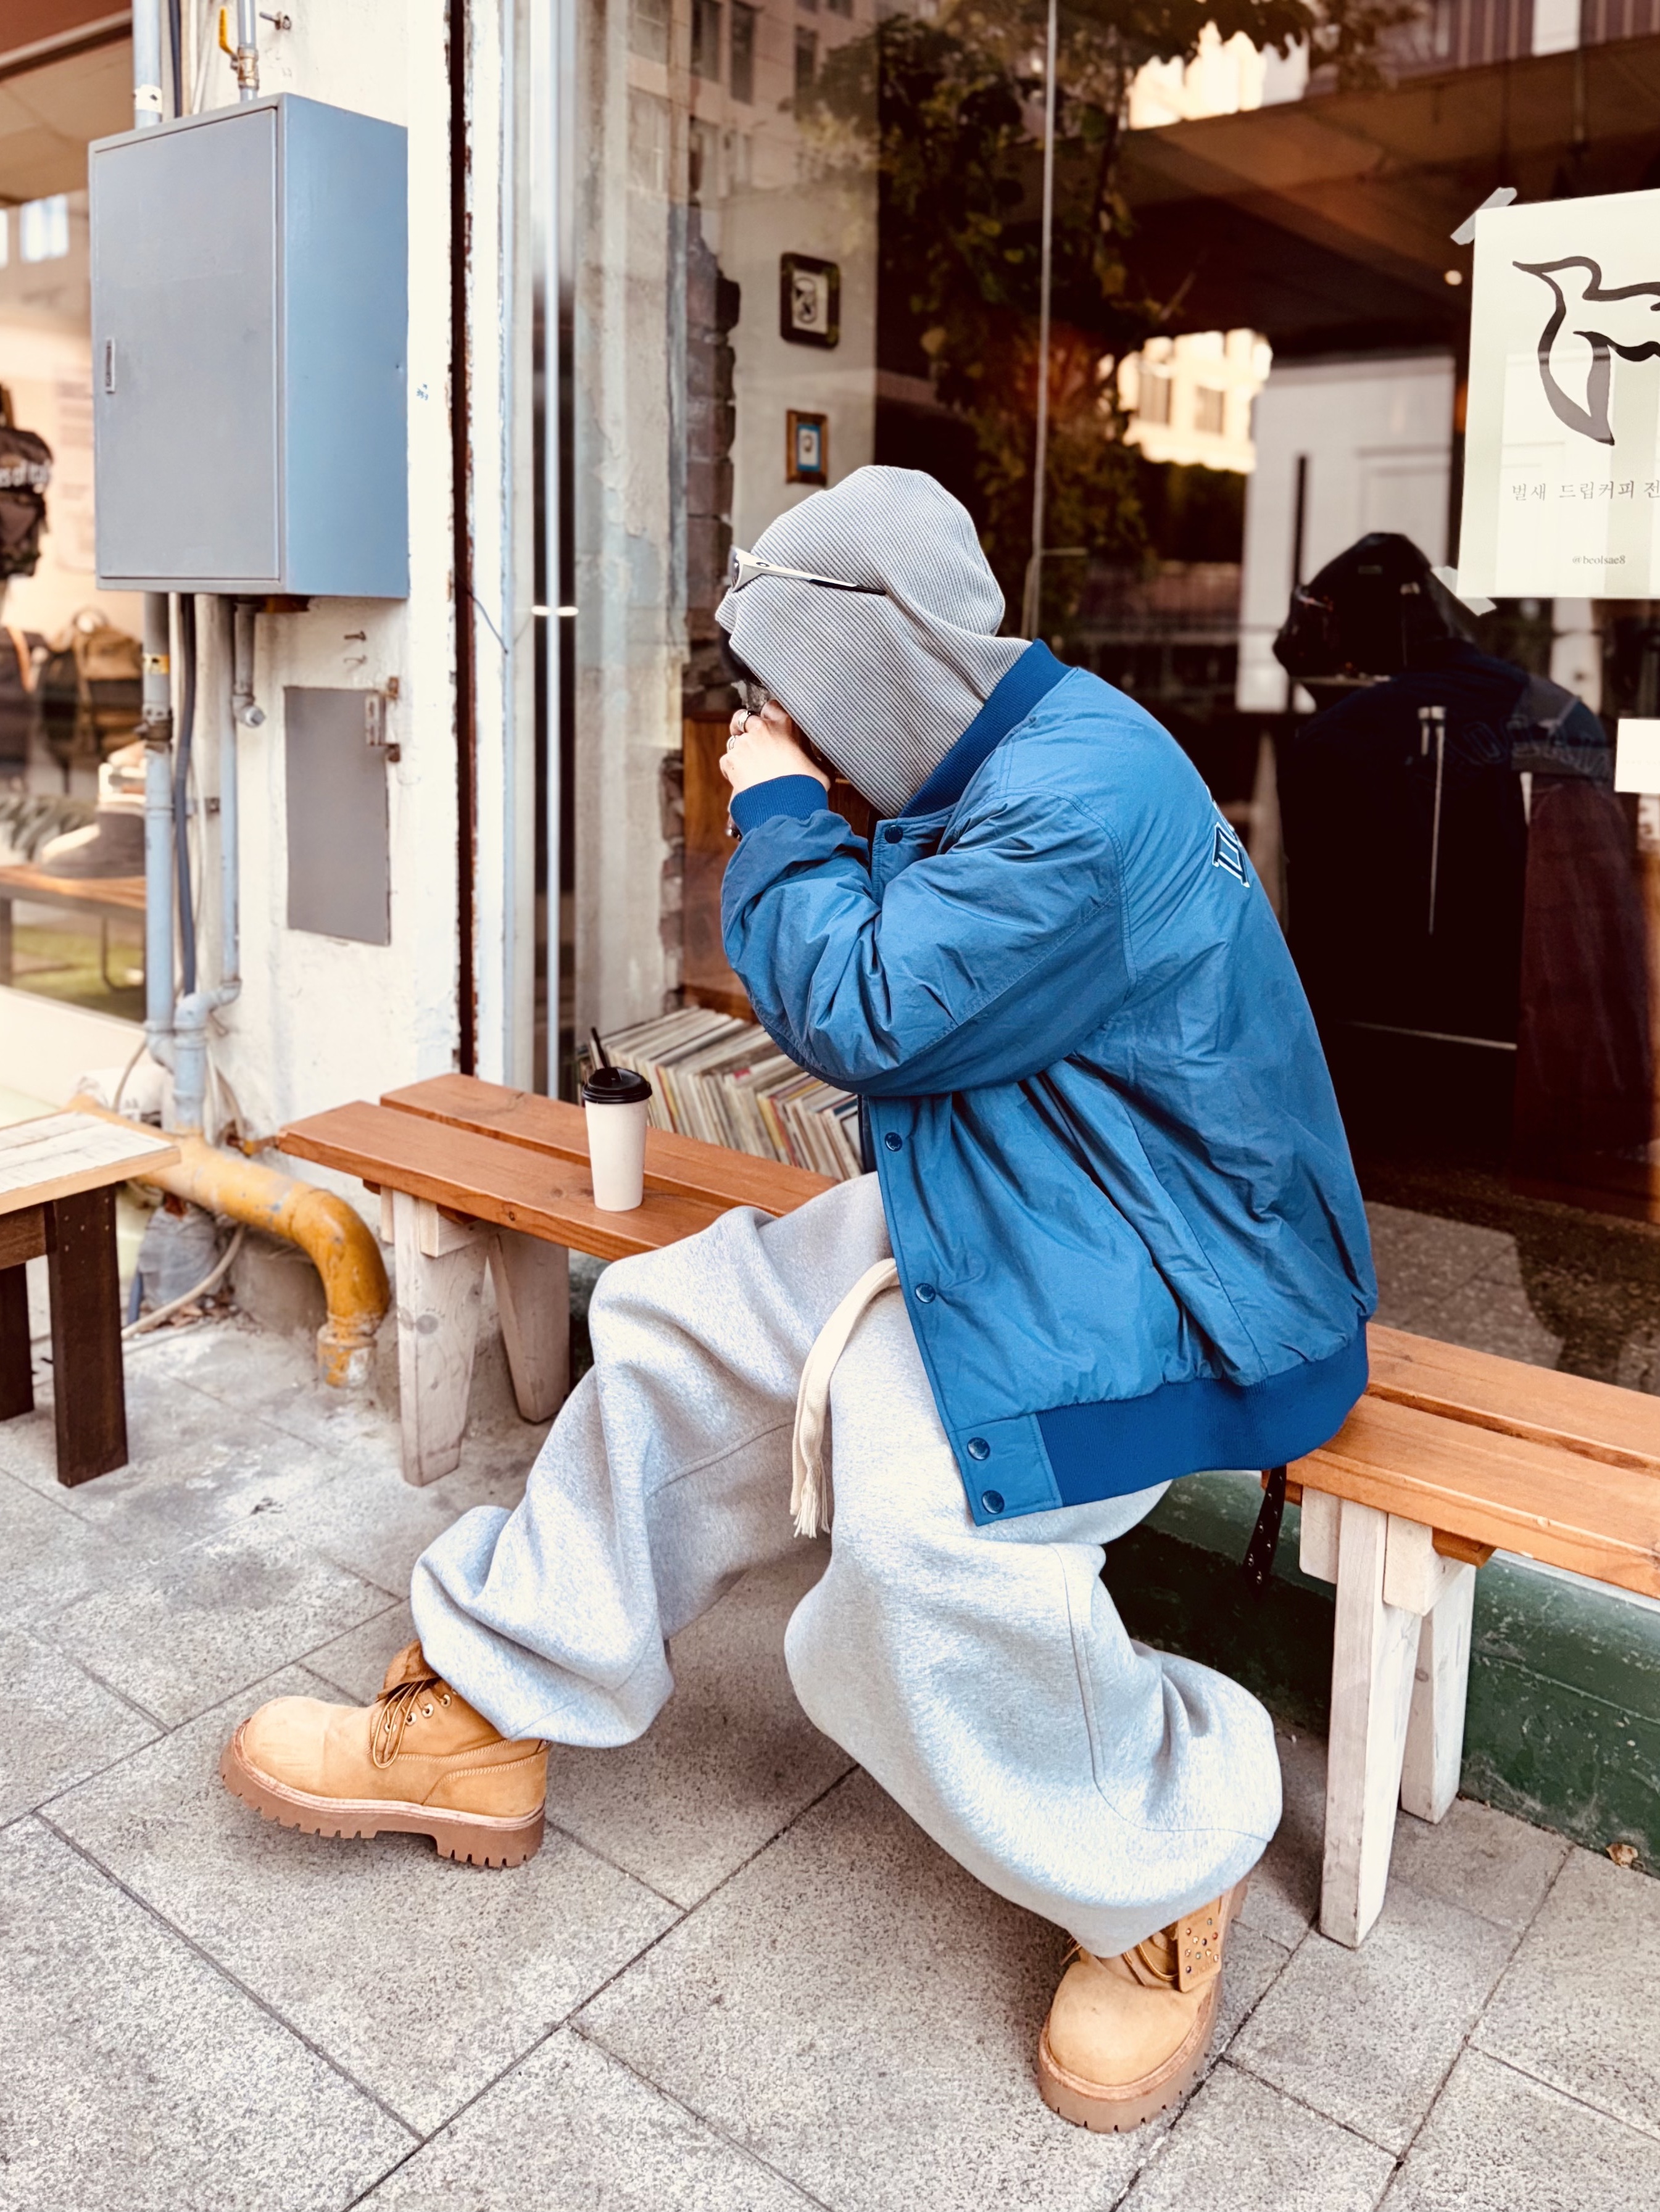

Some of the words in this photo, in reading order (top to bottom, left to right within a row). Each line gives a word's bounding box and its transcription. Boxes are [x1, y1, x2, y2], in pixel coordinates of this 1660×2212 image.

[1512, 483, 1546, 501] 벌새
[1559, 480, 1634, 500] 드립커피
[1572, 555, 1625, 565] @beolsae8
